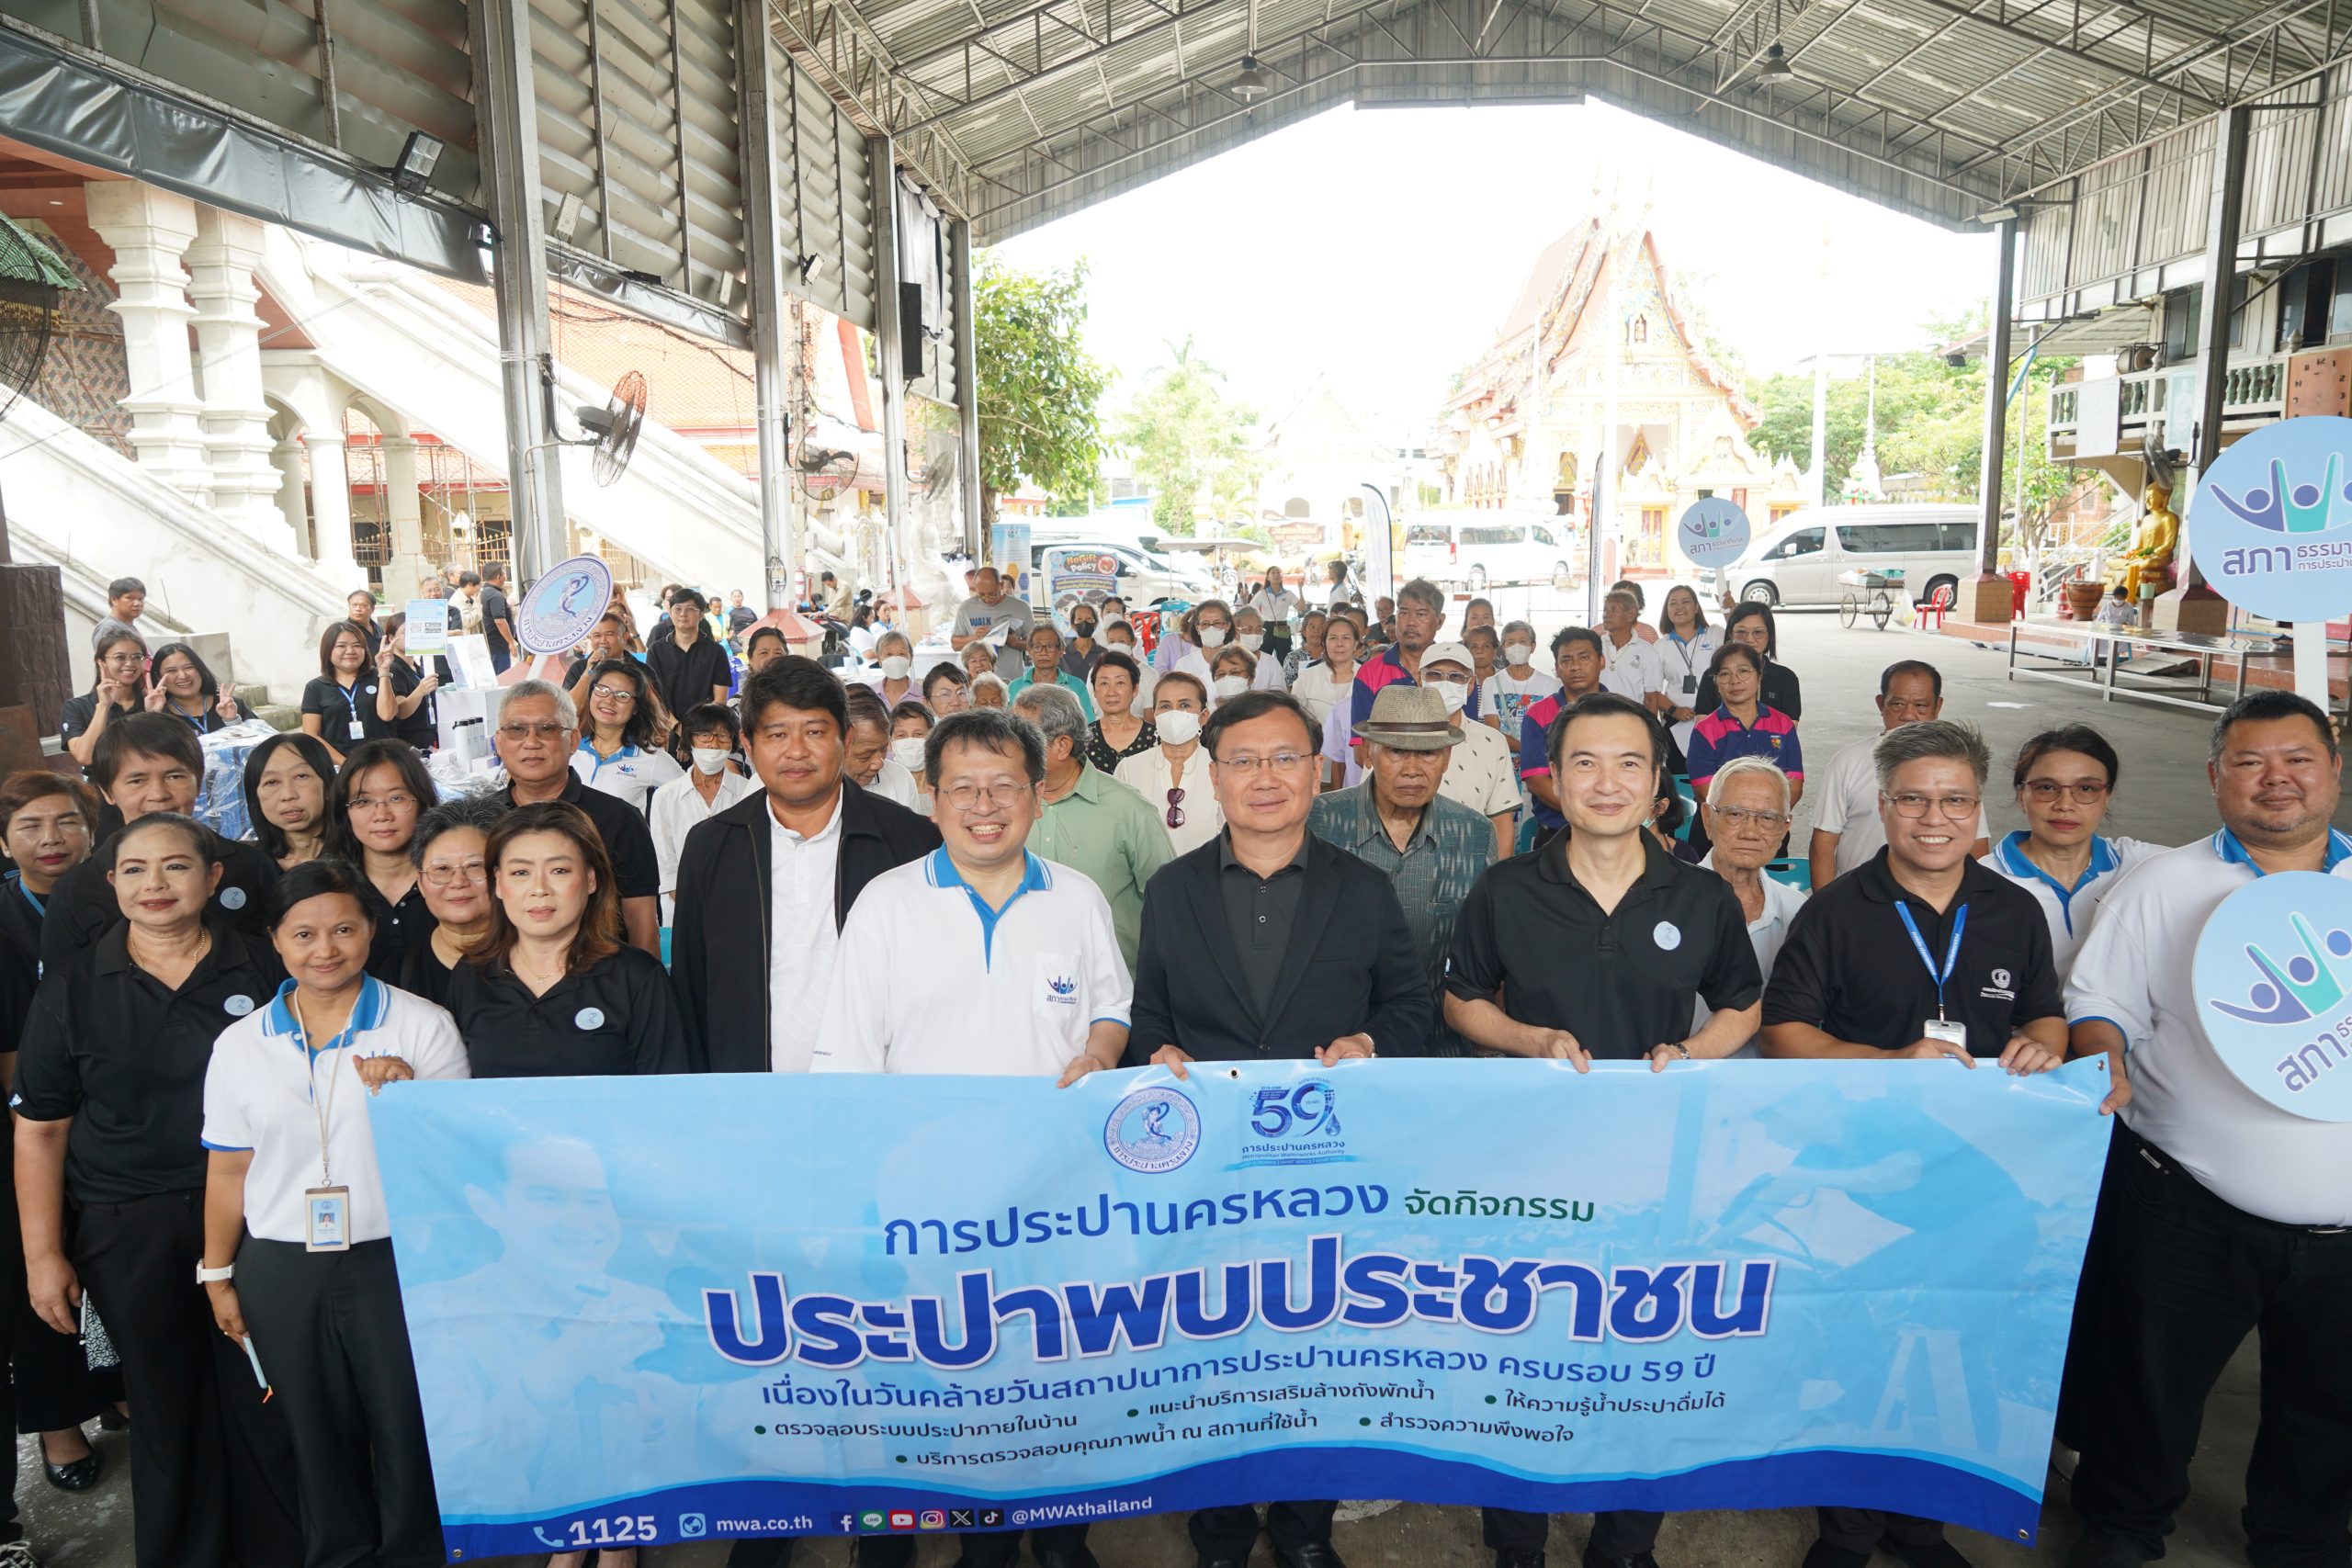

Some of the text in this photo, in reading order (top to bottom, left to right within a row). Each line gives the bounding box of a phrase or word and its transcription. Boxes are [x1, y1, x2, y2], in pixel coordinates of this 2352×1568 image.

[1690, 542, 1712, 554] สภา
[2222, 546, 2292, 575] สภา
[2276, 1032, 2348, 1092] สภา
[1250, 1081, 1335, 1139] 59
[1113, 1140, 1193, 1169] การประปานครหลวง
[1241, 1141, 1346, 1154] การประปานครหลวง
[1317, 1148, 1345, 1156] Authority
[884, 1184, 1595, 1255] การประปานครหลวง จัดกิจกรรม
[703, 1235, 1779, 1370] ประปาพบประชาชน
[762, 1345, 1716, 1408] เนื่องในวันคล้ายวันสถาปนาการประปานครหลวง ครบรอบ 59 ปี
[1148, 1379, 1436, 1416] แนะนำบริการเสริมล้างถังพักน้ำ
[1505, 1388, 1725, 1416] ให้ความรู้น้ำประปาดื่มได้
[775, 1414, 1078, 1438] ตรวจสอบระบบประปาภายในบ้าน
[917, 1408, 1318, 1466] บริการตรวจสอบคุณภาพน้ำ ณ สถานที่ใช้น้ำ
[1379, 1412, 1575, 1442] สำรวจความพึงพอใจ
[716, 1516, 813, 1532] mwa.co.th
[1012, 1496, 1153, 1525] @MWAthailand
[568, 1515, 658, 1546] 1125
